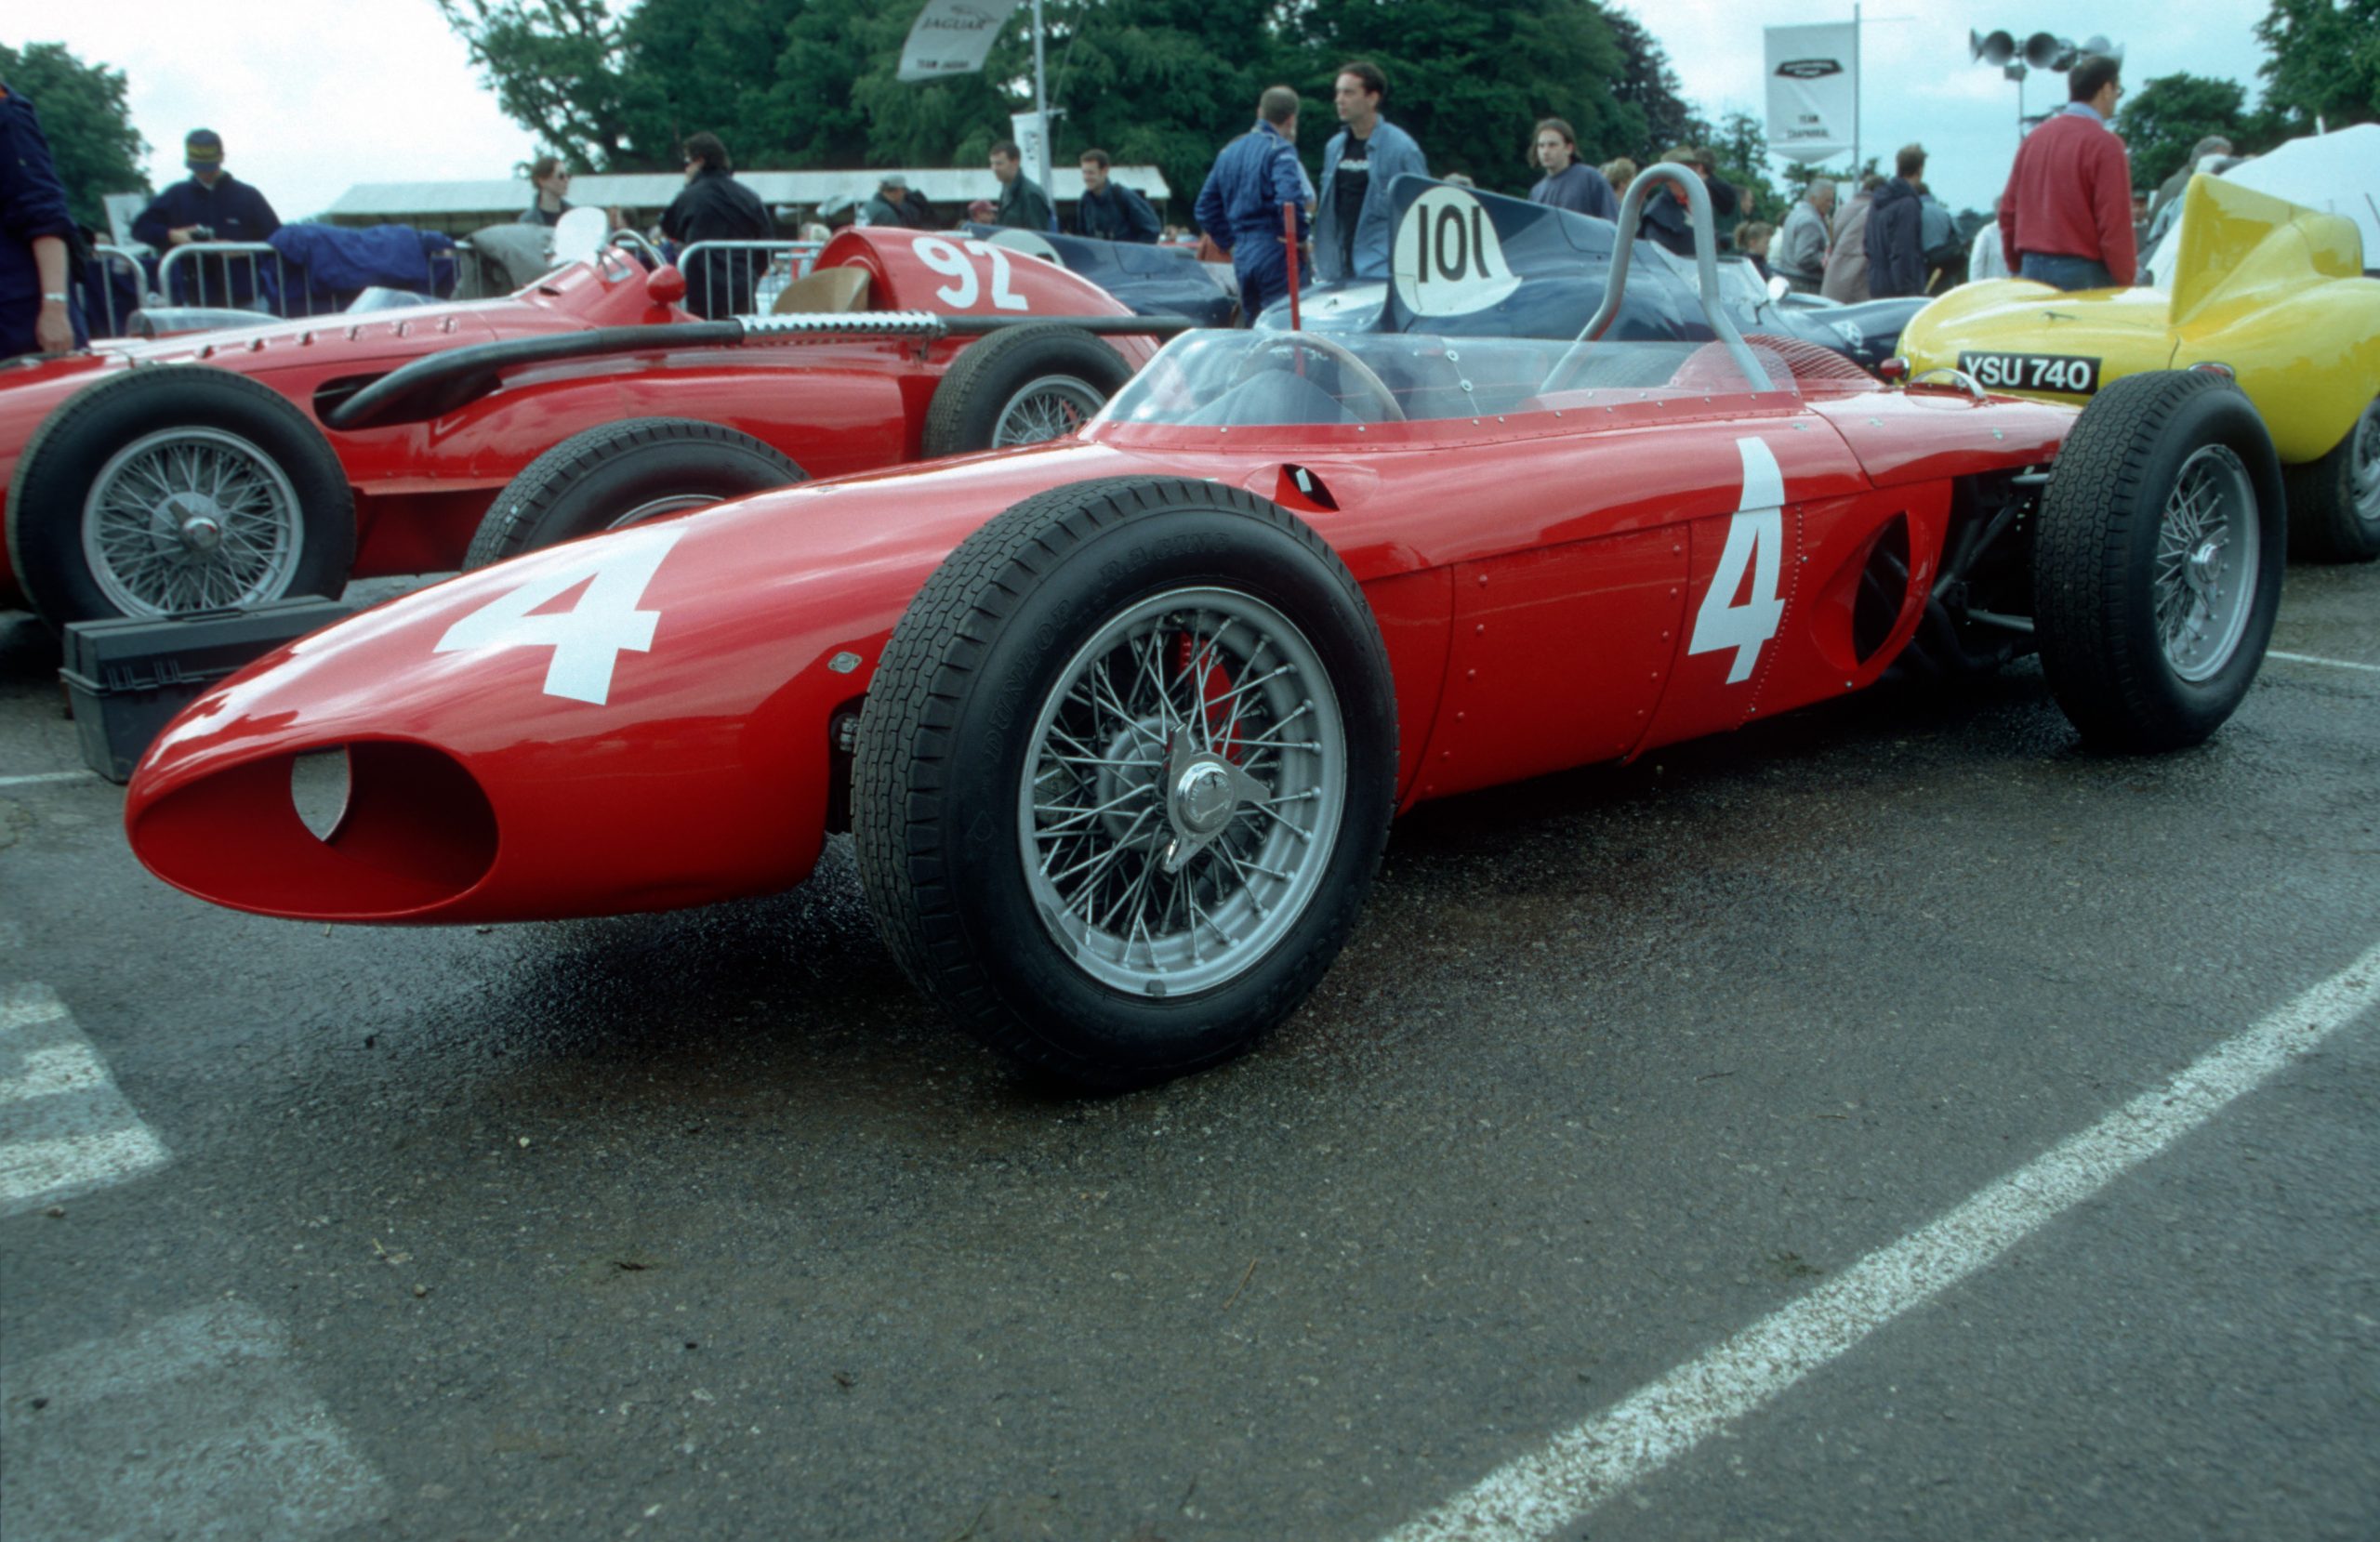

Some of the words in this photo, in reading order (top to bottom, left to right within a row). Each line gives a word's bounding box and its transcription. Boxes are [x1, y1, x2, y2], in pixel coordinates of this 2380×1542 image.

[921, 17, 986, 31] JAGUAR
[912, 236, 1029, 311] 92
[1418, 203, 1491, 283] 101
[1964, 355, 2022, 387] YSU
[2030, 359, 2091, 391] 740
[1687, 436, 1786, 685] 4
[433, 523, 690, 705] 4
[984, 598, 1071, 764] DUNLOP
[1099, 530, 1232, 583] RACING
